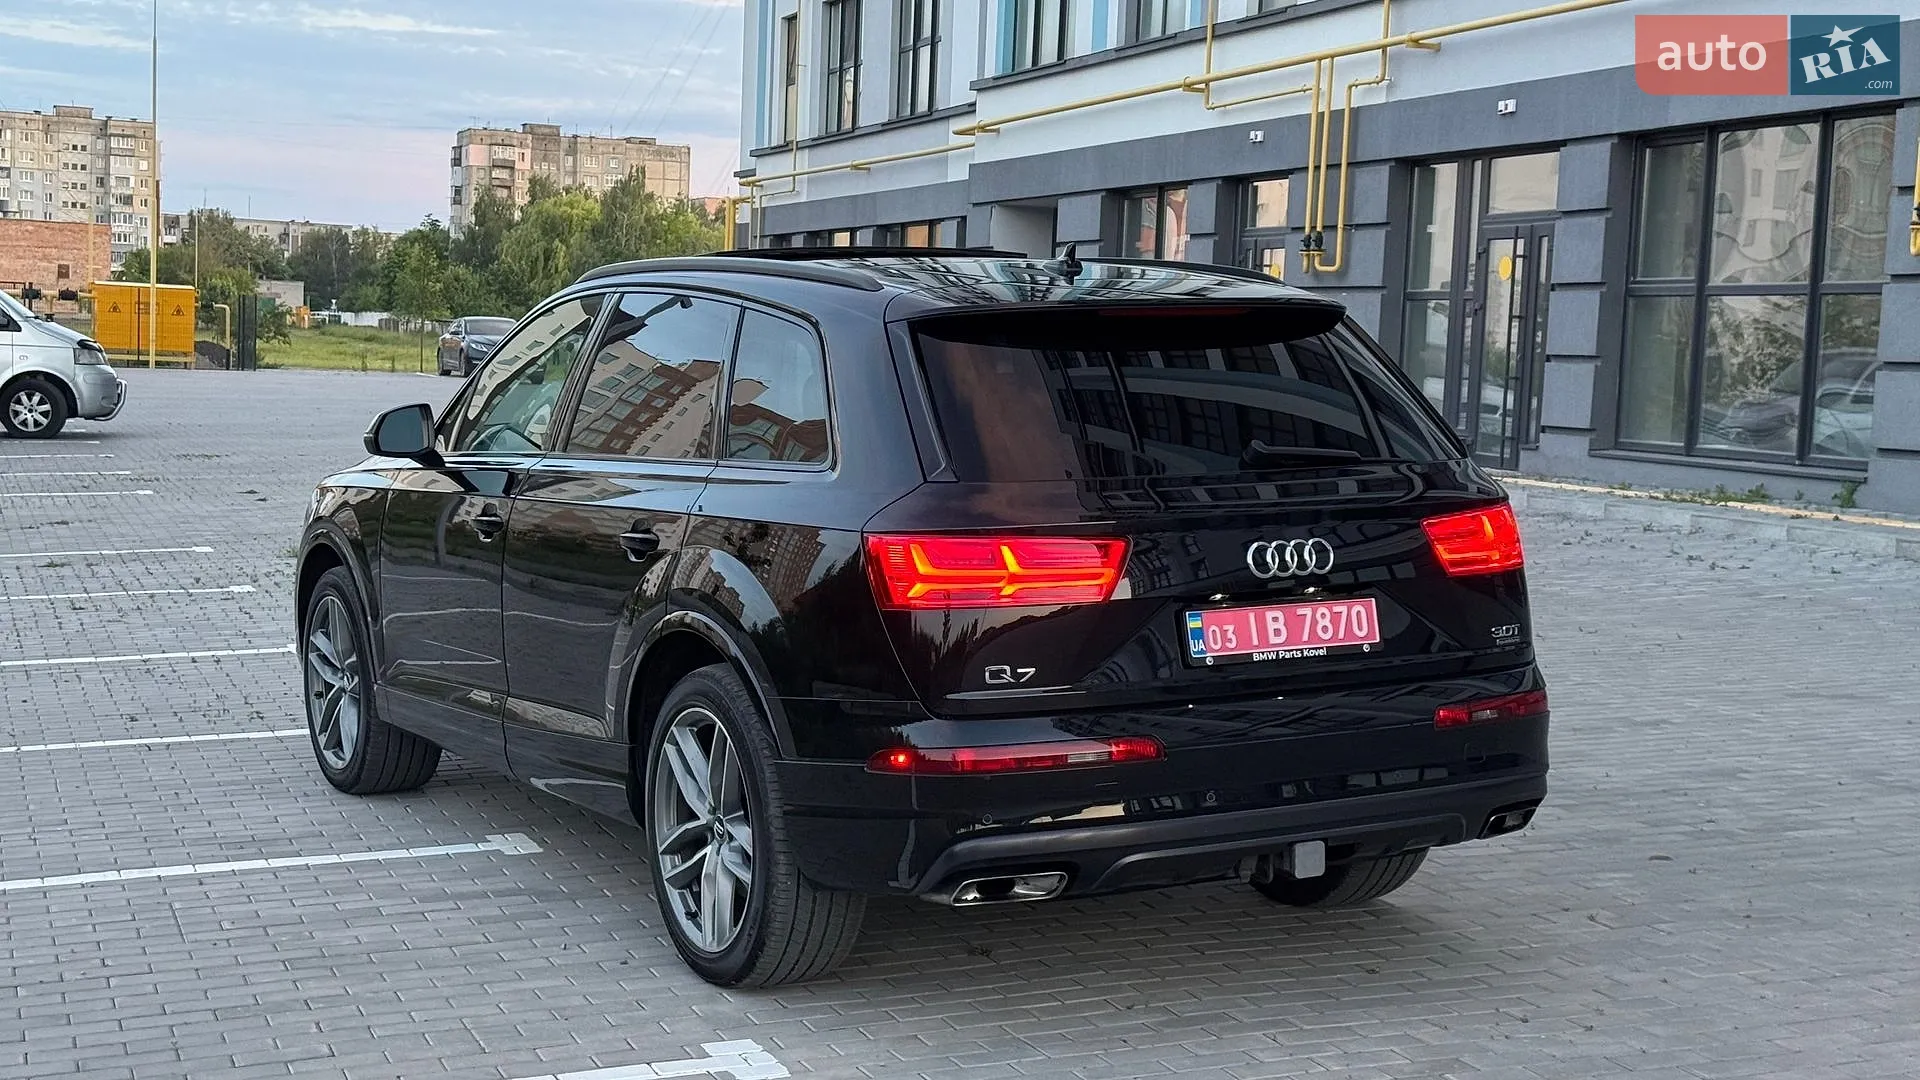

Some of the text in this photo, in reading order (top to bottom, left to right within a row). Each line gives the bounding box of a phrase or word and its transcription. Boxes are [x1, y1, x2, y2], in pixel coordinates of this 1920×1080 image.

[1208, 604, 1369, 651] 03 IB 7870
[1191, 639, 1206, 651] UA
[1252, 646, 1327, 662] BMW Parts Kovel
[984, 665, 1036, 684] Q7
